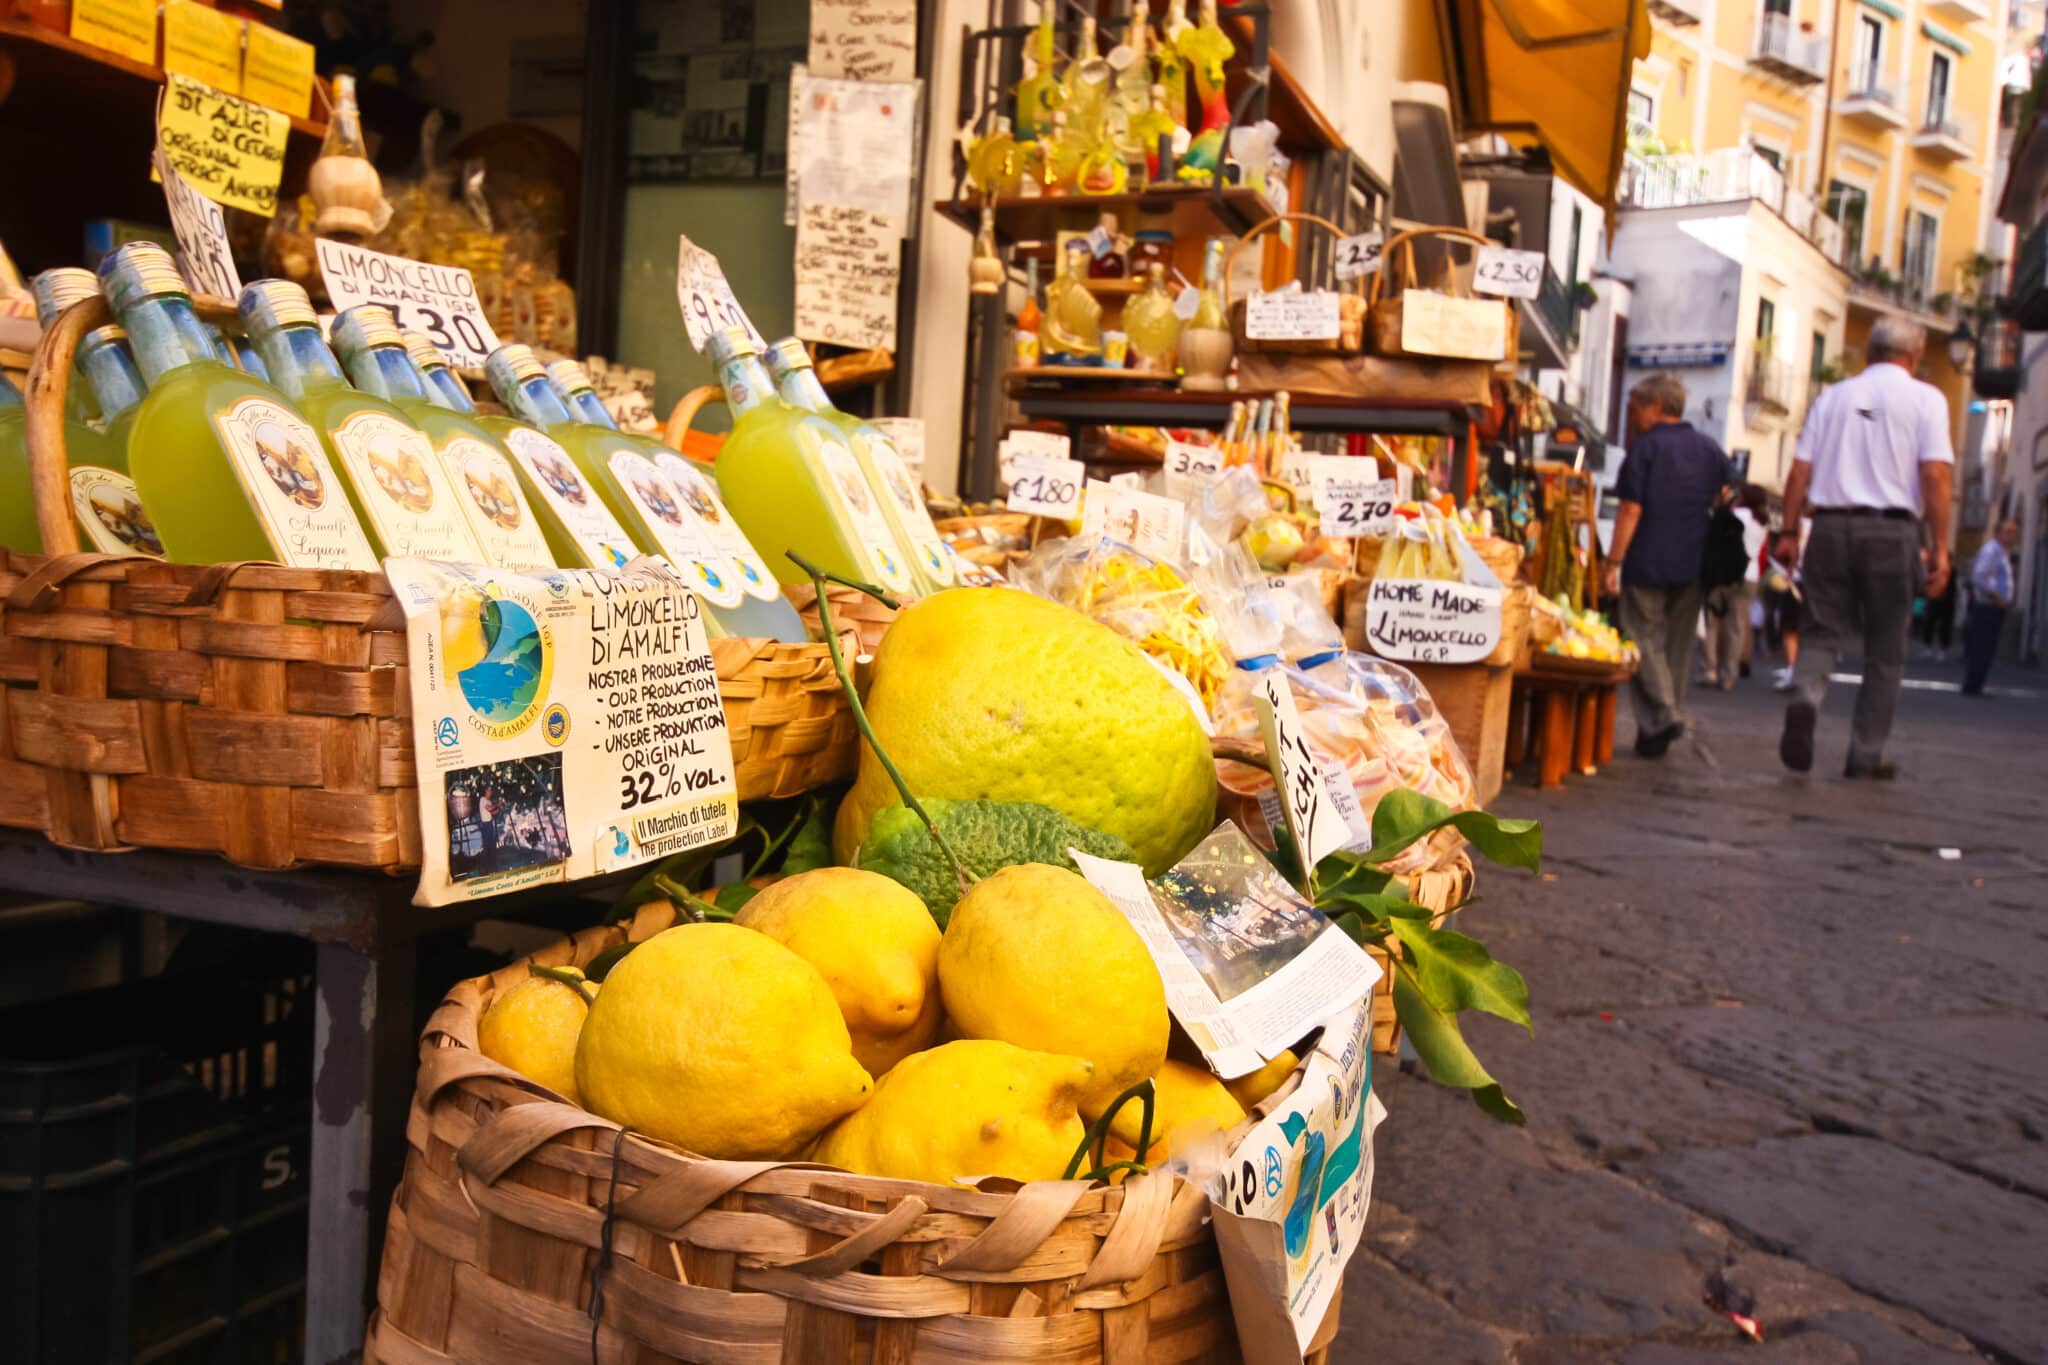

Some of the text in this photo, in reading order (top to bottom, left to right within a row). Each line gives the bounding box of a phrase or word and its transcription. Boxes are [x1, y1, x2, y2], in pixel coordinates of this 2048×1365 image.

[322, 246, 473, 298] LIMONCELLO
[1337, 501, 1392, 527] 2,70
[1374, 584, 1485, 614] HOME MADE
[588, 655, 715, 690] NOSTRA PRODUZIONE
[609, 675, 716, 707] OUR PRODUCTION
[607, 694, 718, 730] NOTRE PRODUCTION
[605, 711, 726, 753] UNSERE PRODUKTION
[622, 739, 705, 771] ORIGINAL
[620, 763, 681, 810] 32%
[648, 810, 688, 837] Marchio
[690, 806, 699, 821] di
[701, 801, 727, 821] tutela
[659, 830, 706, 857] protection
[706, 822, 729, 840] Label
